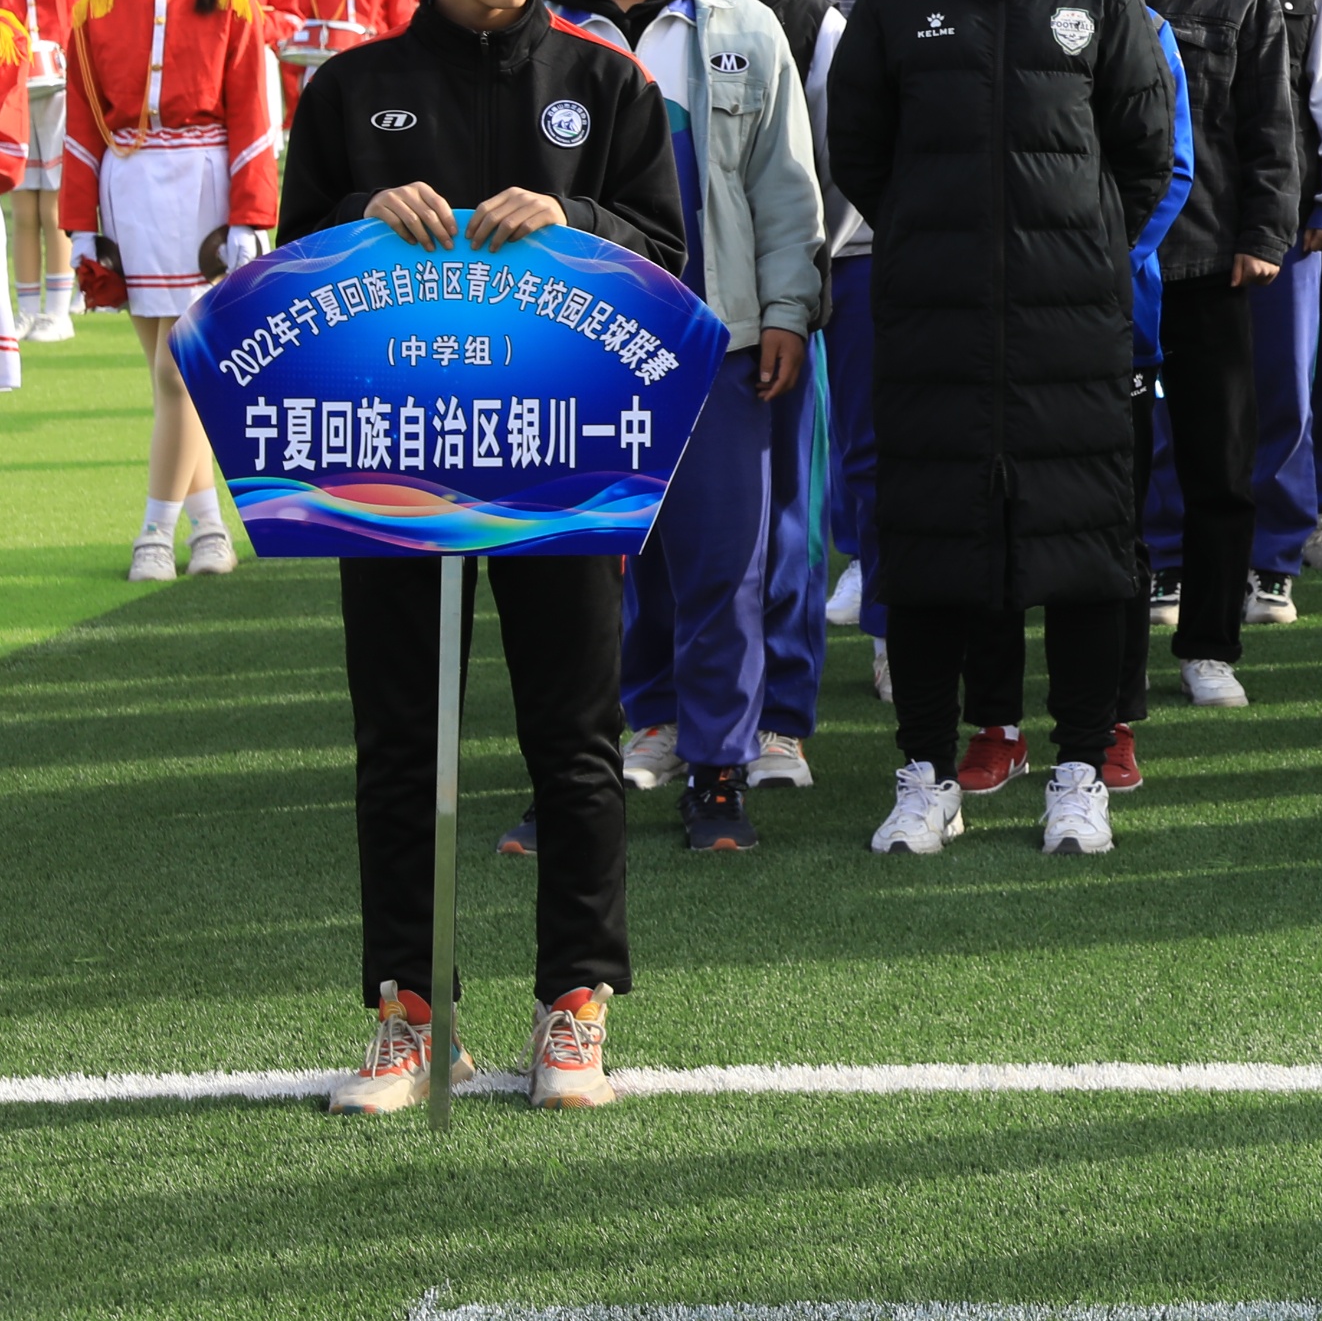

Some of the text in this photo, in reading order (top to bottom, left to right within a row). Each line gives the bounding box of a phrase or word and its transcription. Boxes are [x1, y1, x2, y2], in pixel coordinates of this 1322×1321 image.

[917, 27, 956, 39] KELME
[720, 53, 739, 71] M
[218, 260, 681, 389] 2022年宁夏回族自治区青少年校园足球联赛
[244, 394, 654, 473] 宁夏回族自治区银川一中
